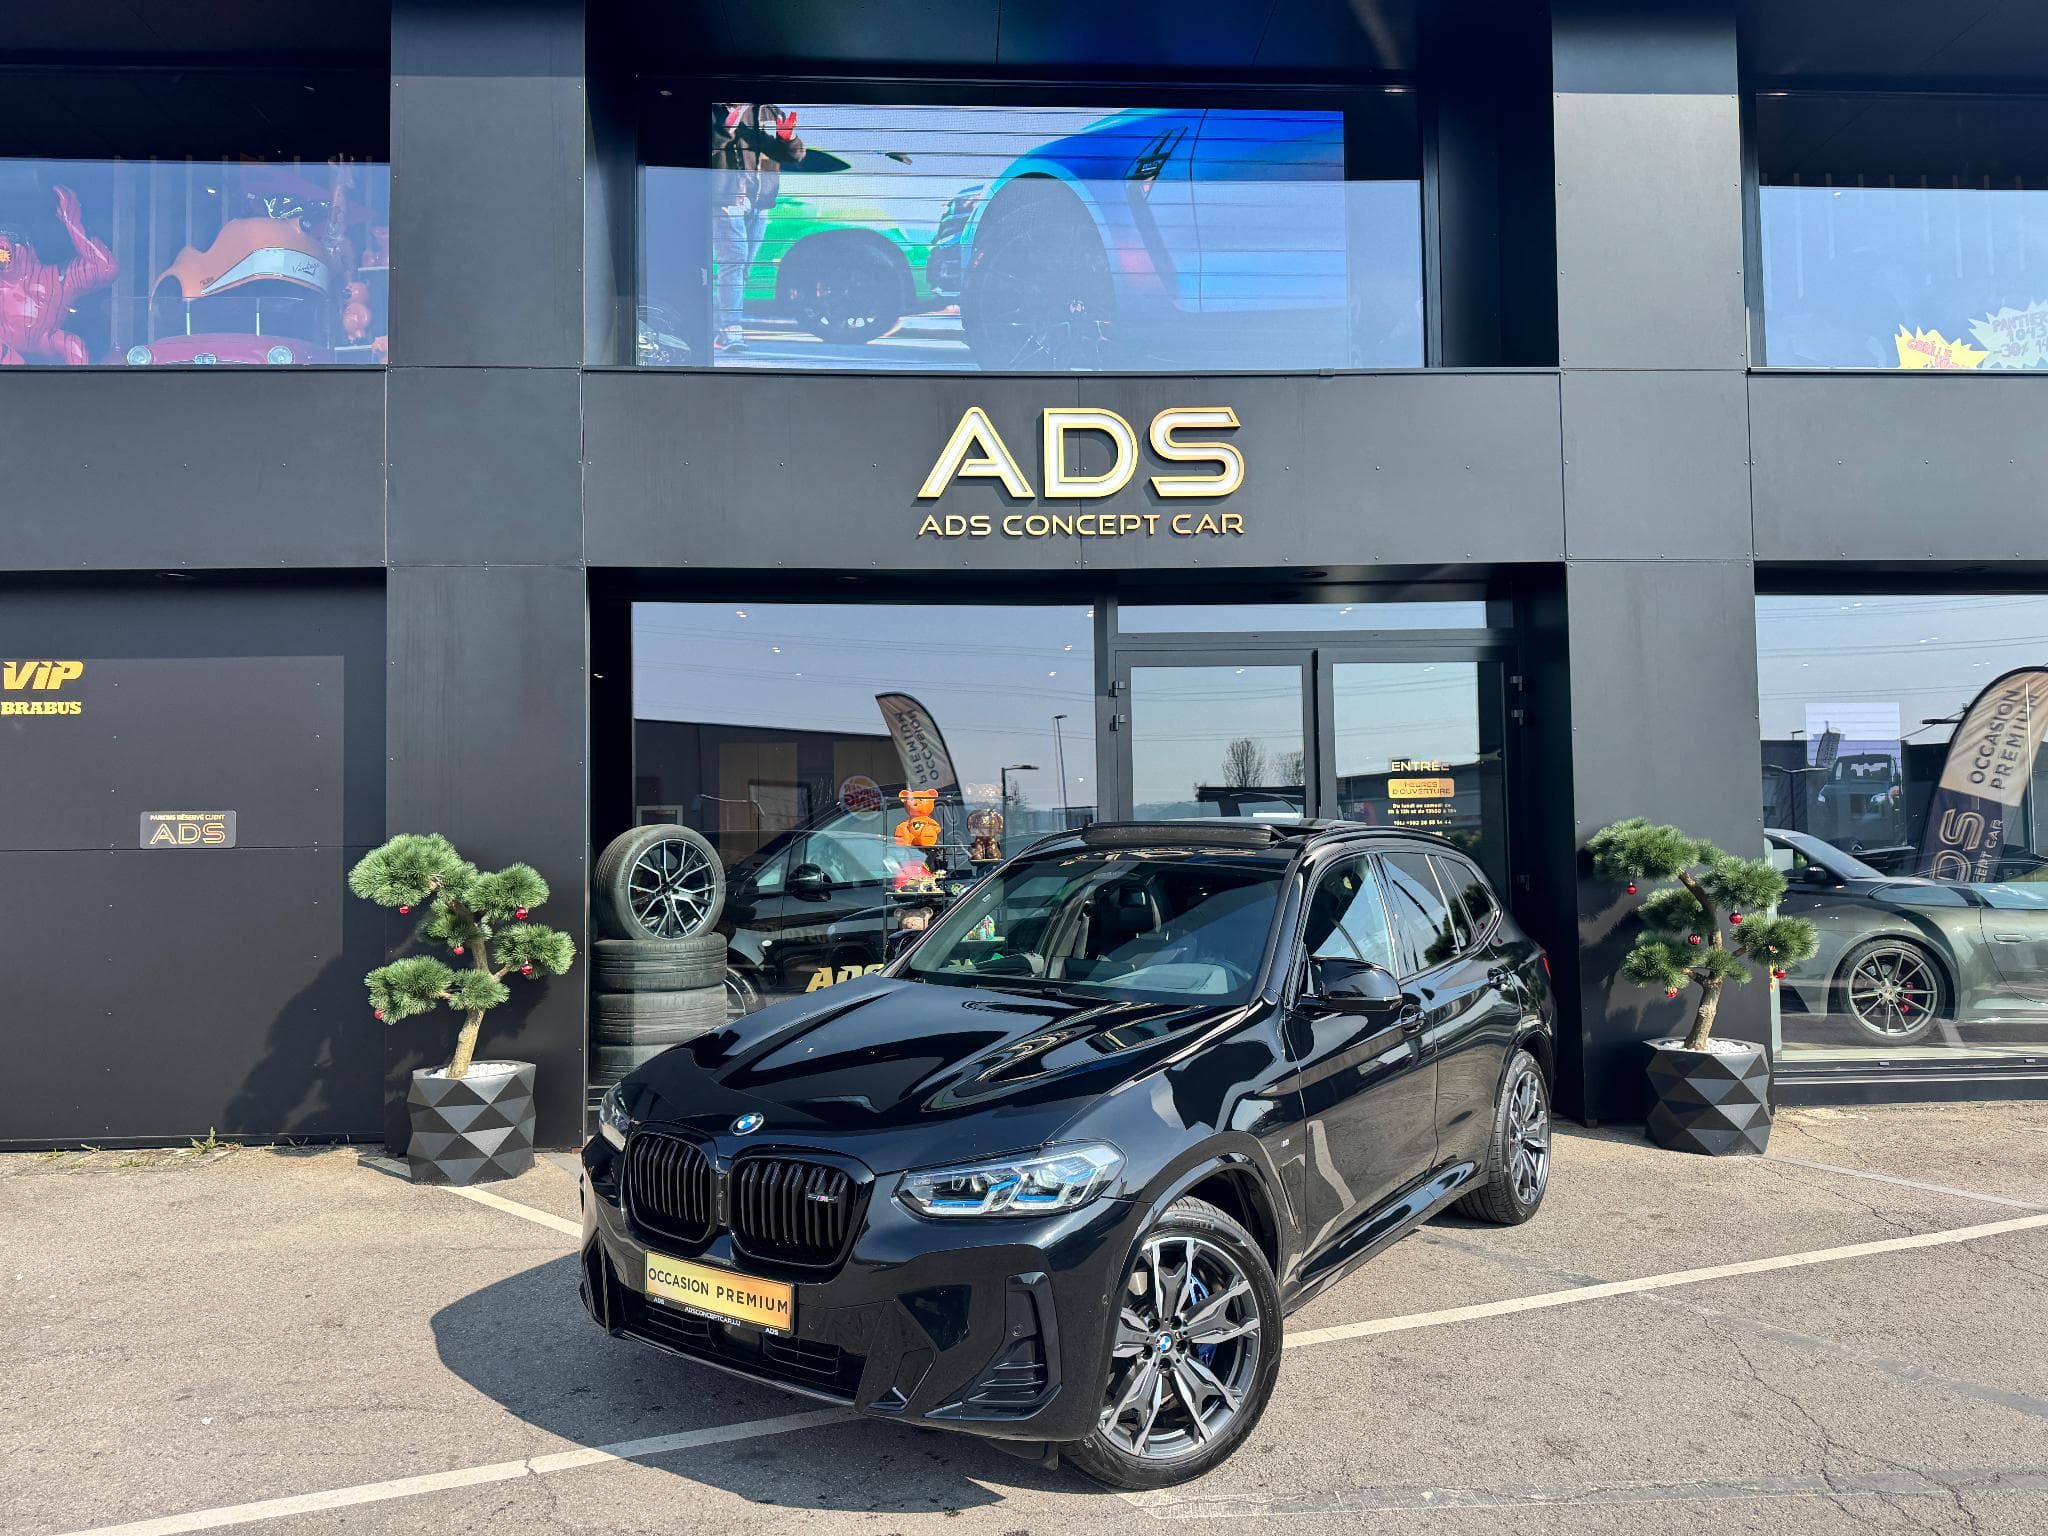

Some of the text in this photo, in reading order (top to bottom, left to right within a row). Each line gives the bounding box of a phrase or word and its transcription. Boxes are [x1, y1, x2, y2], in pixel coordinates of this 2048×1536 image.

[917, 406, 1245, 498] ADS
[918, 513, 1245, 536] ADS CONCEPT CAR
[0, 701, 82, 715] BRABUS
[1969, 690, 2021, 785] OCCASION
[1989, 693, 2040, 790] PREMIUM
[149, 823, 225, 845] ADS
[1932, 808, 1985, 882] DS
[648, 1267, 788, 1315] OCCASION PREMIUM
[653, 1296, 665, 1305] ADS
[765, 1327, 779, 1336] ADS
